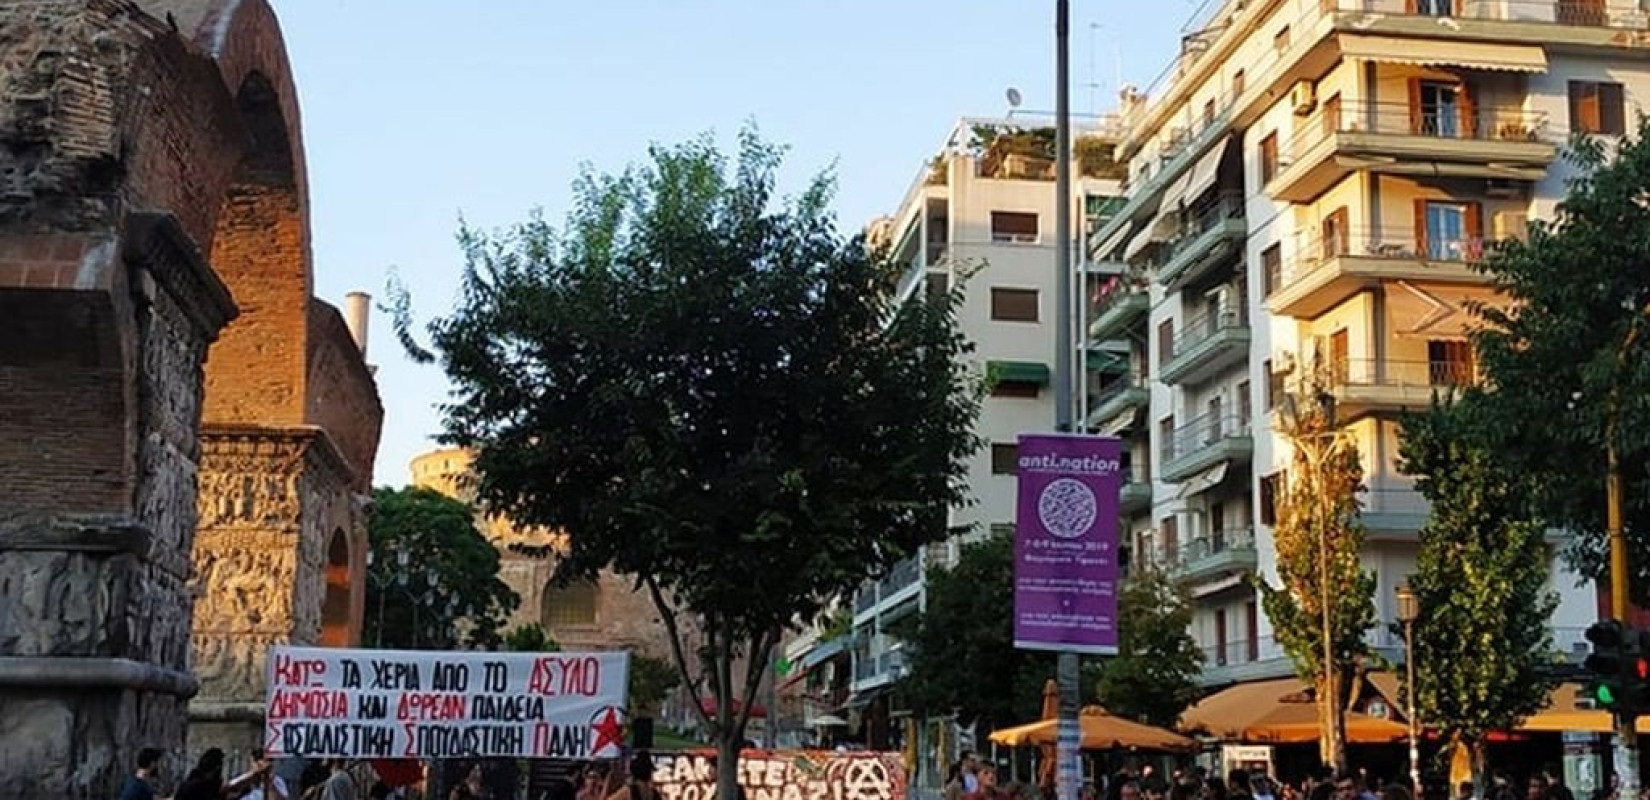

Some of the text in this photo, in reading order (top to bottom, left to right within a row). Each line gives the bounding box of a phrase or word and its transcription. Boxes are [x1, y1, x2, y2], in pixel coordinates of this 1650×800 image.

[341, 659, 361, 690] ΤΑ
[371, 660, 420, 691] ΧΕΡΙΑ
[432, 662, 468, 692] ΑΠΟ
[484, 661, 507, 692] ΤΟ
[529, 657, 599, 697] ΑΣΥΛΟ
[269, 691, 544, 722] ΔΗΜΟΣΙΑ ΚΑΙ ΔΩΡΕΑΝ ΠΑΙΔΕΙΑ
[405, 724, 523, 756] ΣΠΟΥΔΑΣΤΙΚΗ
[533, 724, 586, 757] ΠΑΛΗ
